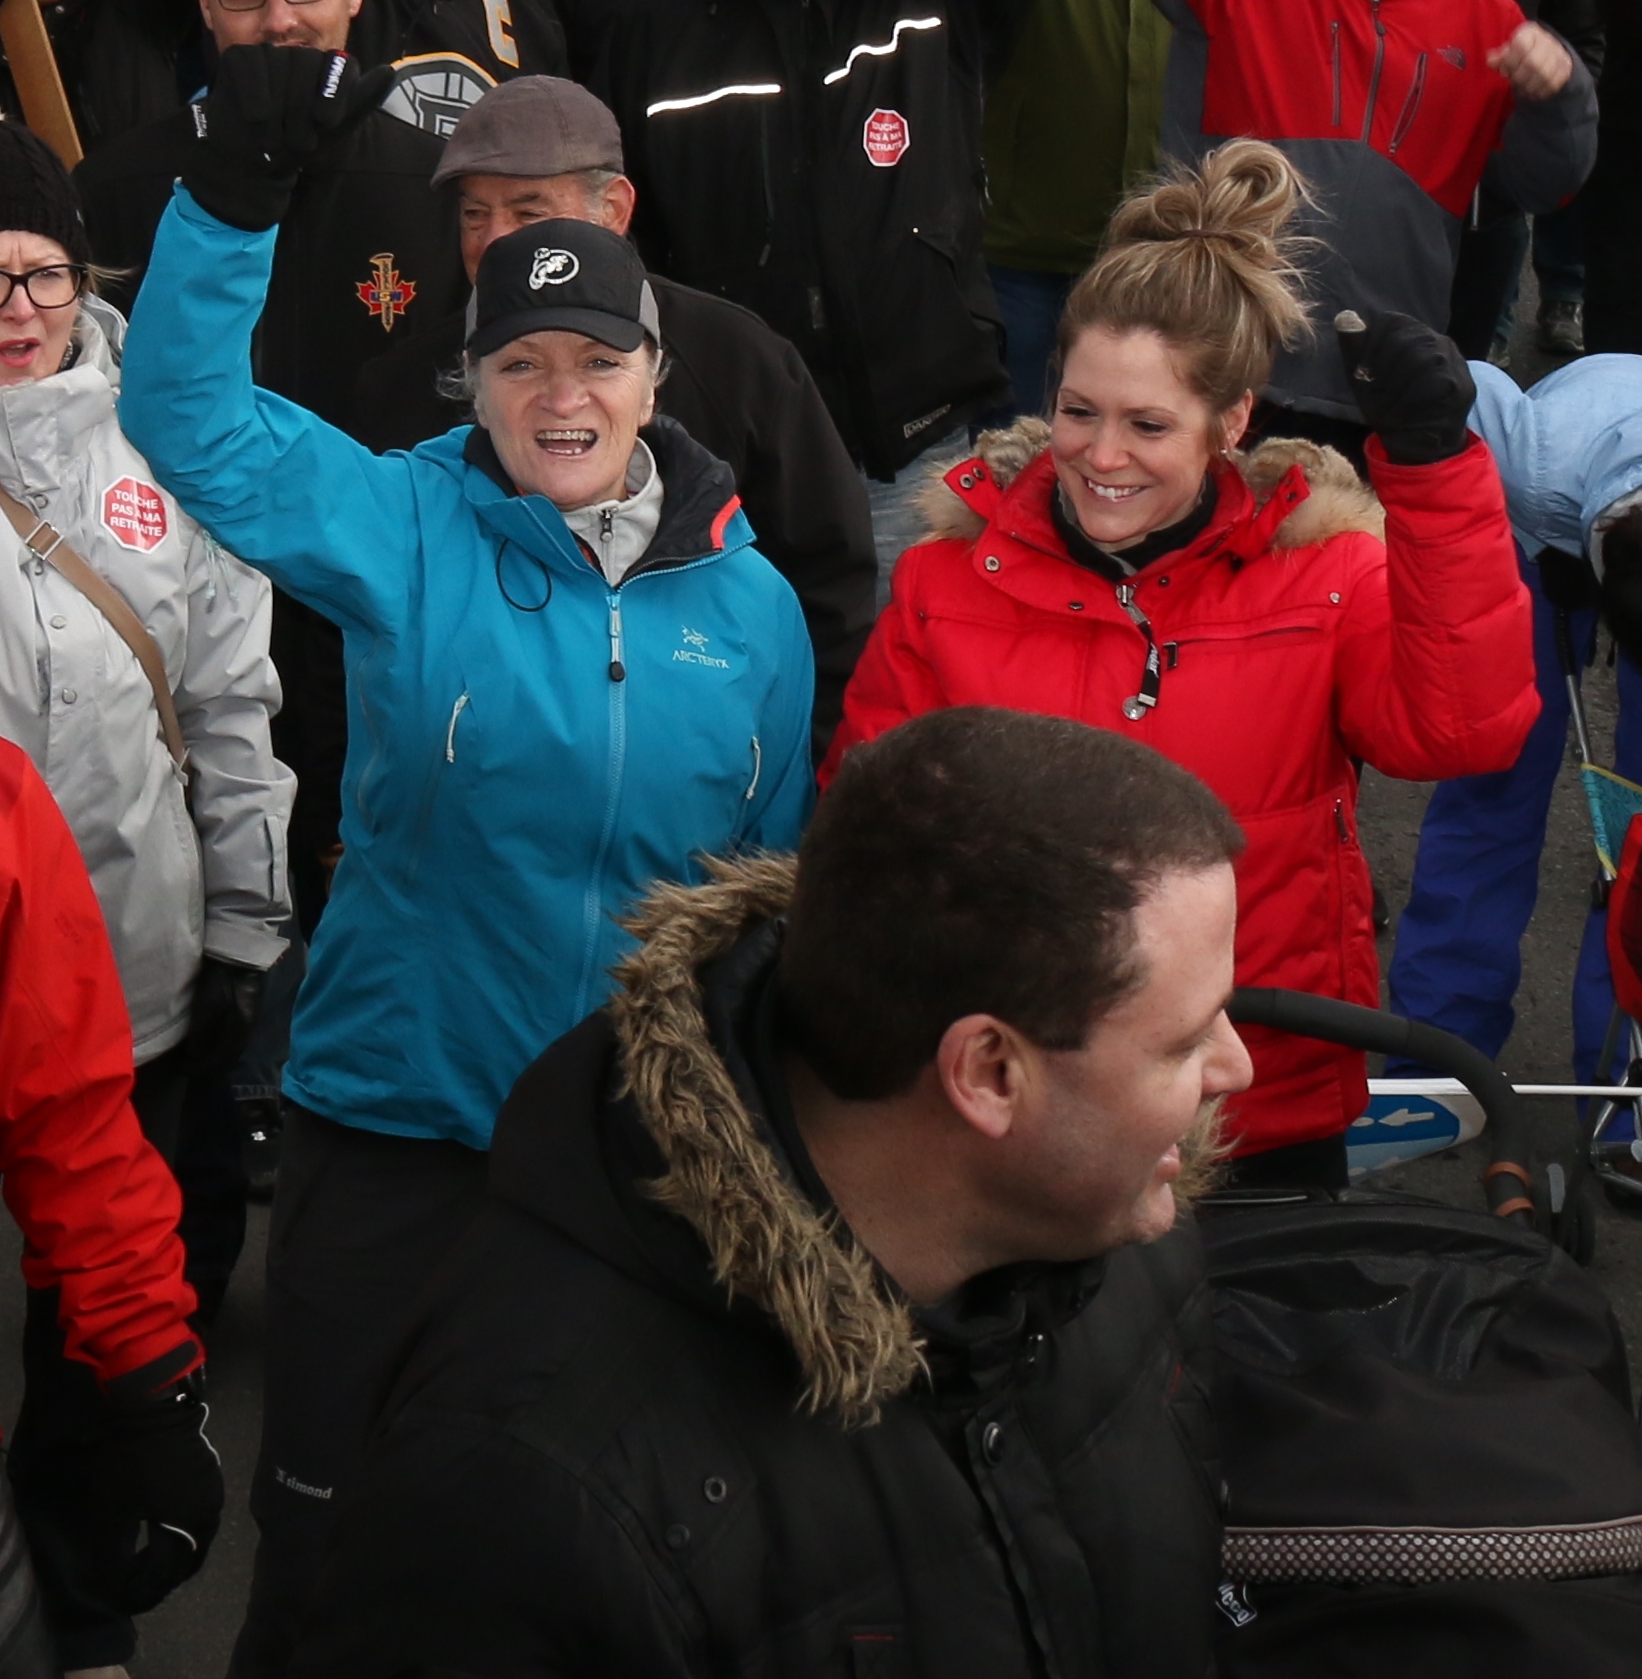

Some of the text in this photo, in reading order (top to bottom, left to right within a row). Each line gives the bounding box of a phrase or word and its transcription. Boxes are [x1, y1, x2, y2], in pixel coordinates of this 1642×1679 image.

[114, 489, 159, 510] TOUCHE
[111, 503, 133, 516] PAS
[142, 511, 162, 523] MA
[110, 516, 163, 537] RETRAITE
